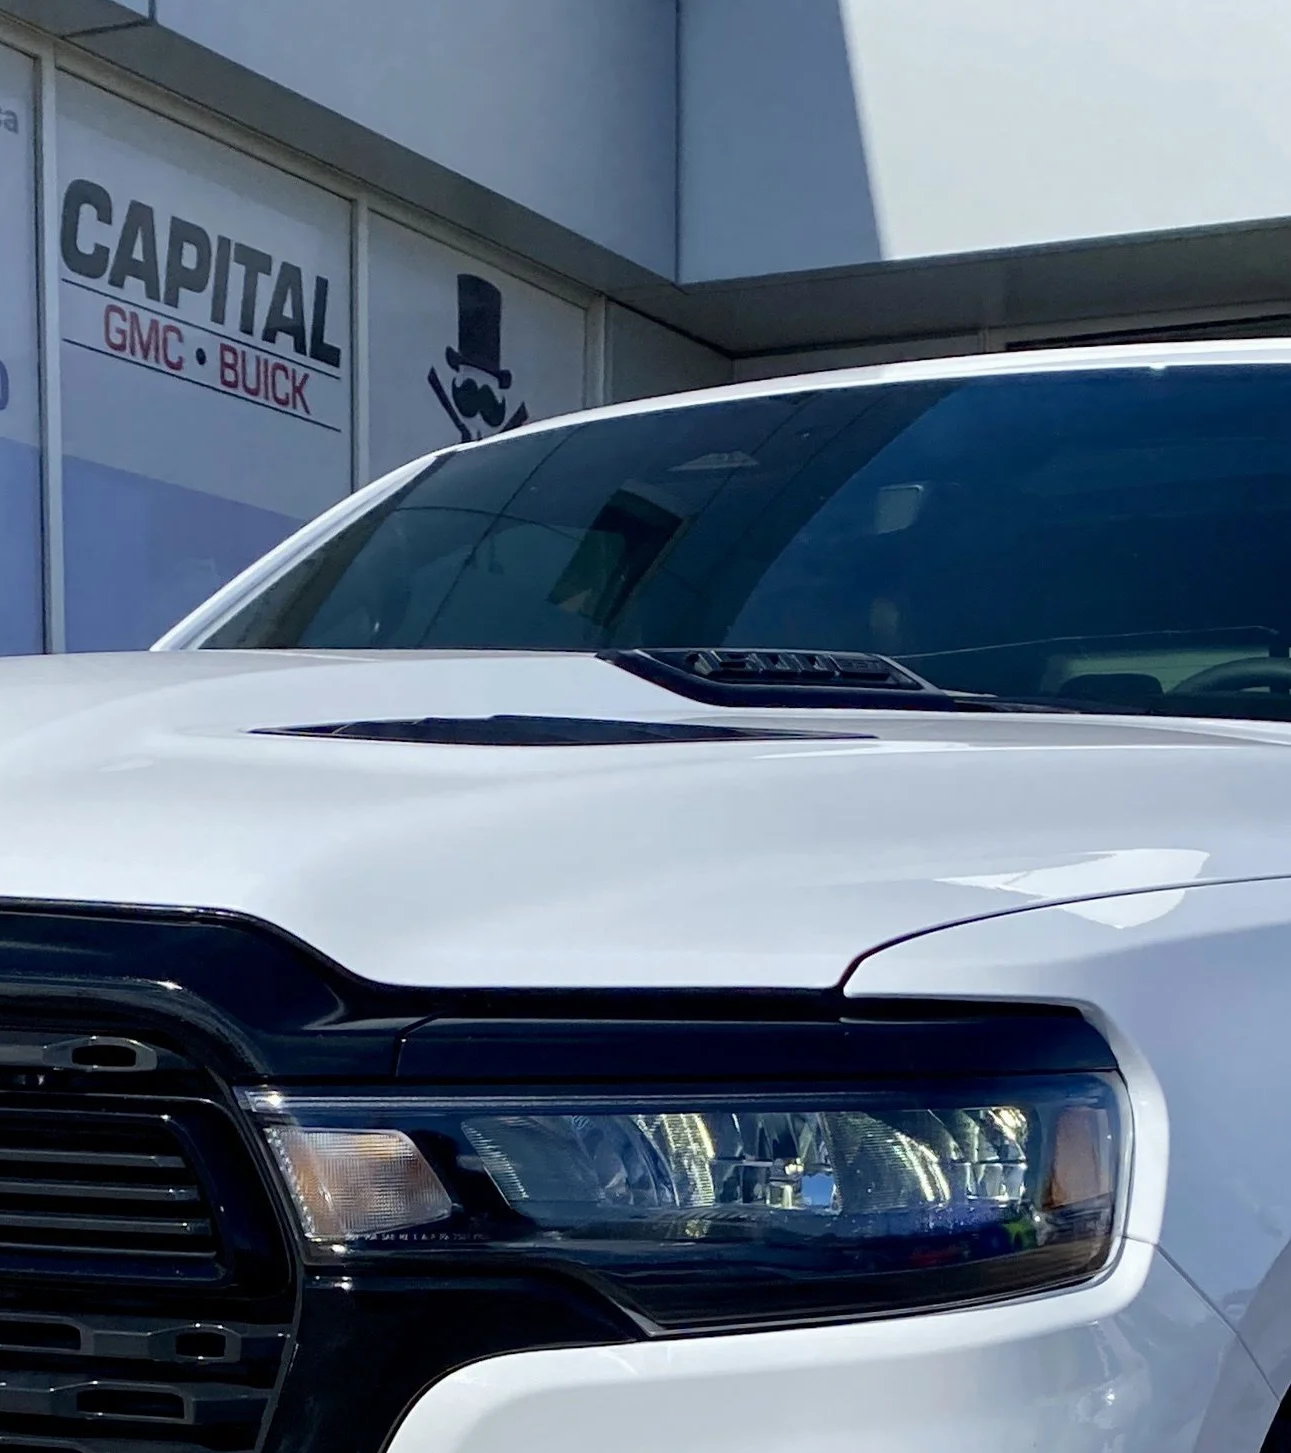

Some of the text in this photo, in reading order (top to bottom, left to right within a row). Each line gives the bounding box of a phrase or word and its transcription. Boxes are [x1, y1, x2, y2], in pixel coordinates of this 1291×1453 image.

[60, 178, 342, 369] CAPITAL
[103, 303, 311, 415] GMC BUICK
